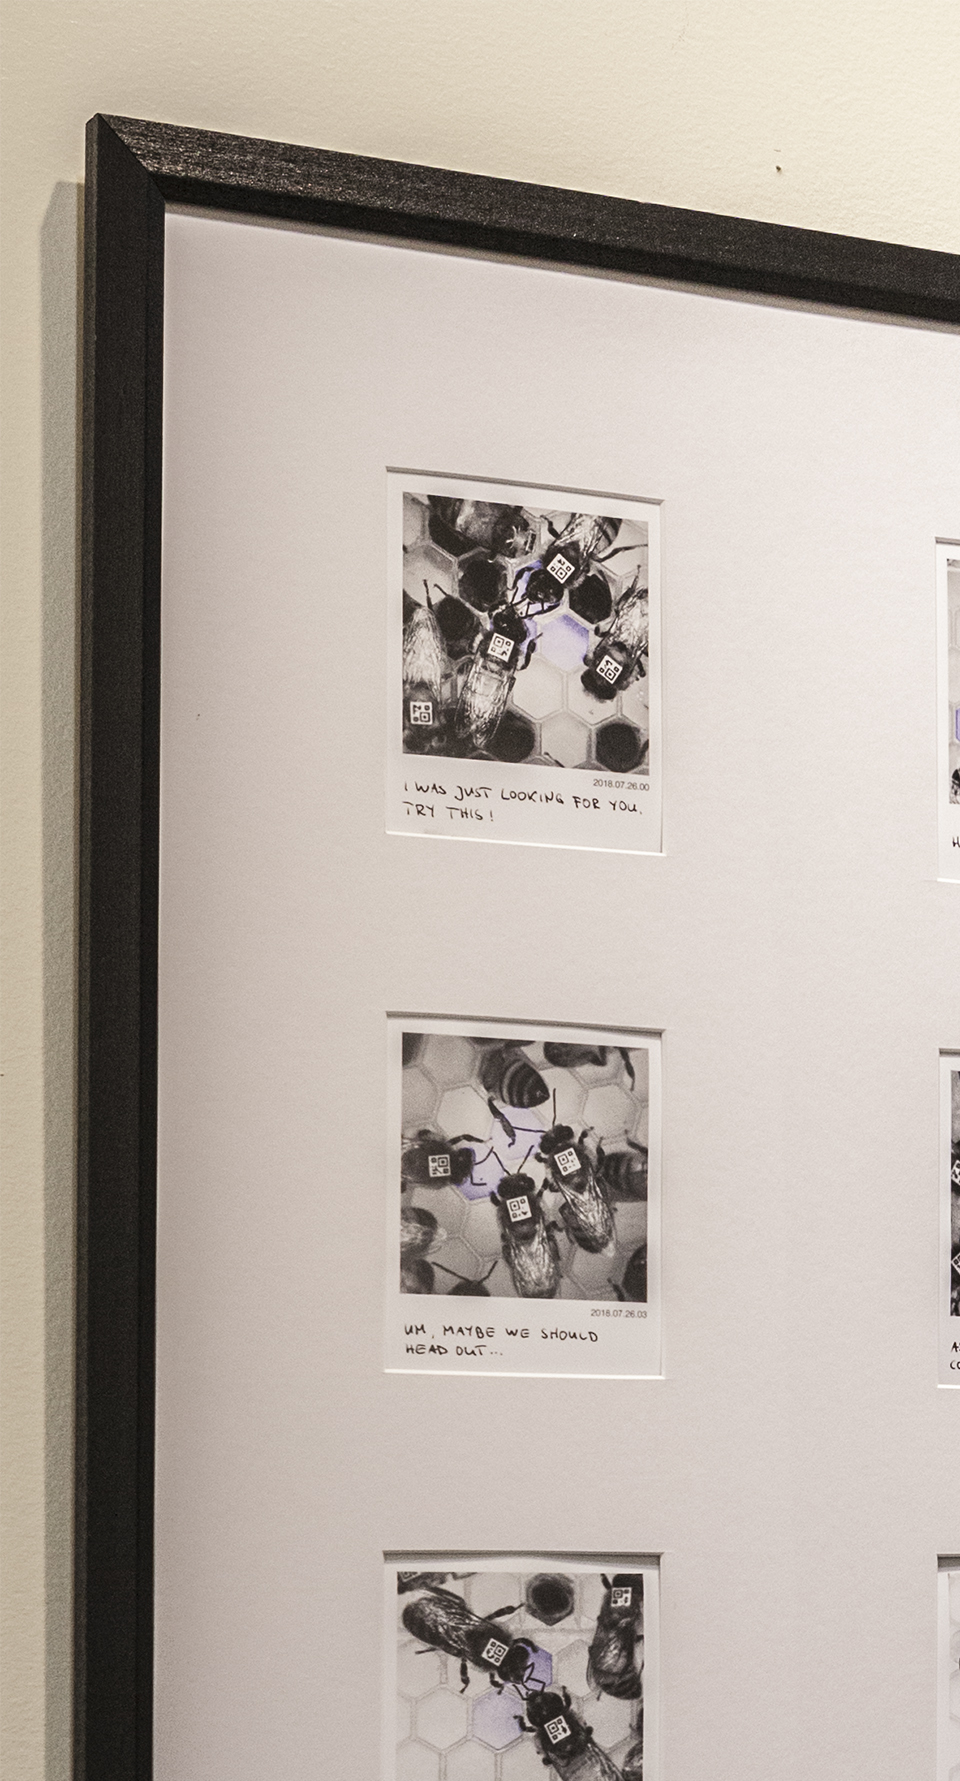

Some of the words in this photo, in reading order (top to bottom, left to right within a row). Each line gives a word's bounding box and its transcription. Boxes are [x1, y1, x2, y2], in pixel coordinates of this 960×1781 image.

[593, 779, 650, 791] 2018.07.26.00
[415, 782, 447, 795] WAS
[454, 786, 492, 801] JUST
[501, 789, 564, 804] LOOKING
[572, 796, 600, 809] FOR
[609, 801, 642, 814] YOU.
[403, 801, 434, 817] TRY
[446, 806, 493, 821] THIS!
[591, 1309, 647, 1318] 2018.07.26.03
[443, 1325, 495, 1339] MAYBE
[541, 1328, 598, 1342] SHOULD
[406, 1344, 448, 1355] HEAD
